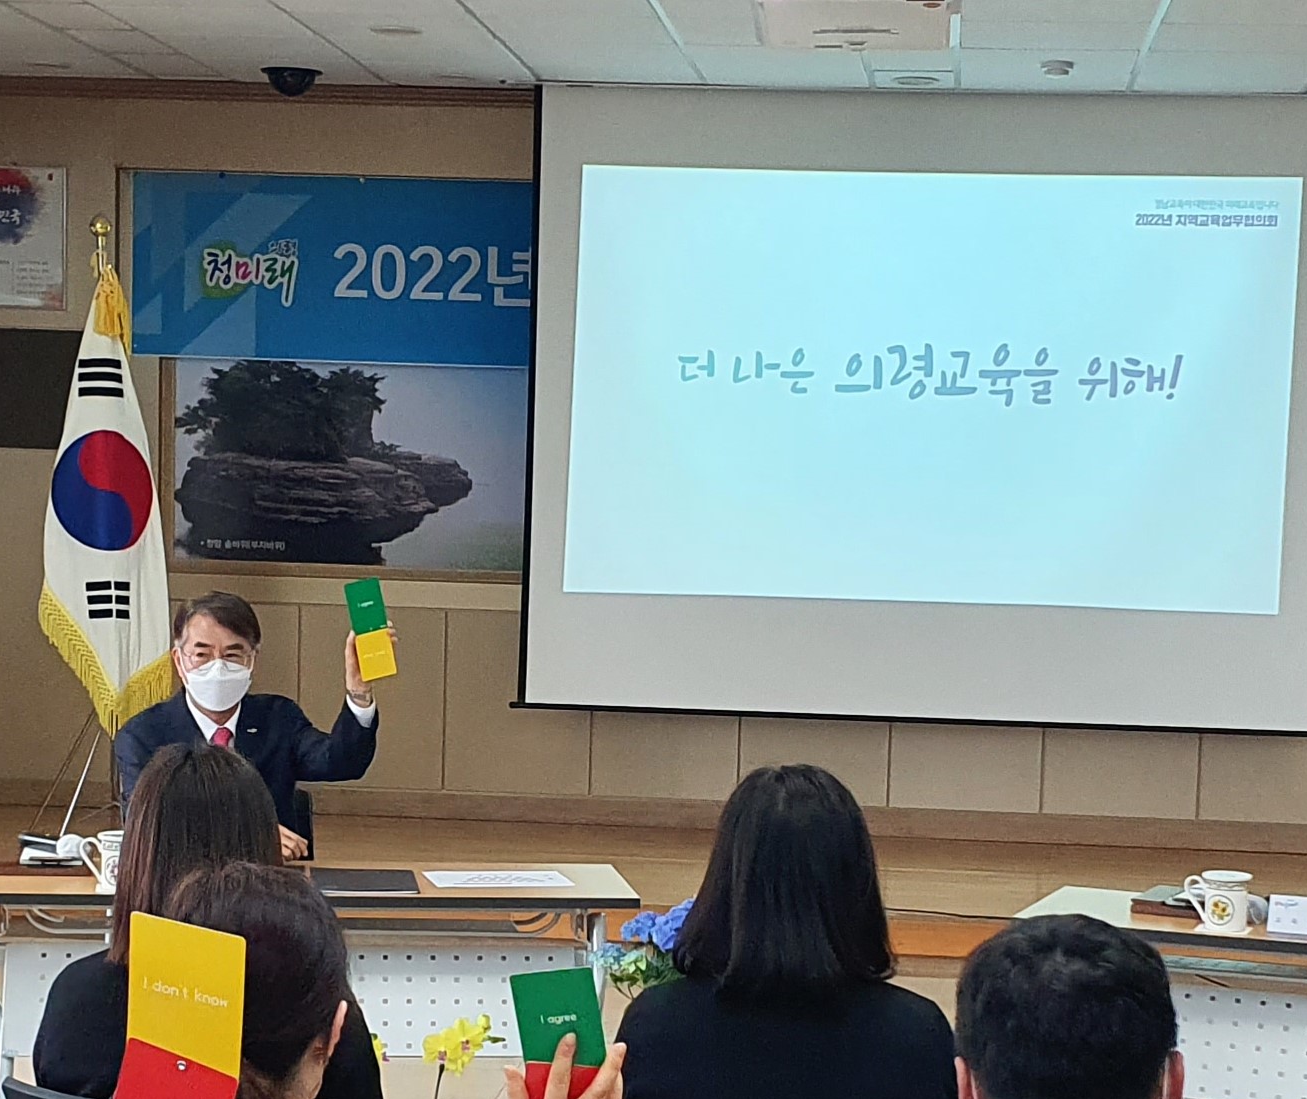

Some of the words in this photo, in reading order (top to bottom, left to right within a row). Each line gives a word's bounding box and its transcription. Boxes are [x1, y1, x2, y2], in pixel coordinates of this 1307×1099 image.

[1135, 213, 1172, 226] 2022년
[1175, 214, 1278, 227] 지역교육업무협의회
[204, 249, 298, 307] 청미래
[334, 243, 530, 307] 2022년
[678, 349, 715, 382] 더
[733, 347, 815, 394] 나은
[835, 343, 1059, 406] 의령교육을
[1078, 354, 1184, 400] 위해!
[152, 983, 189, 1001] don't
[195, 985, 229, 1008] know
[547, 1013, 577, 1025] agree
